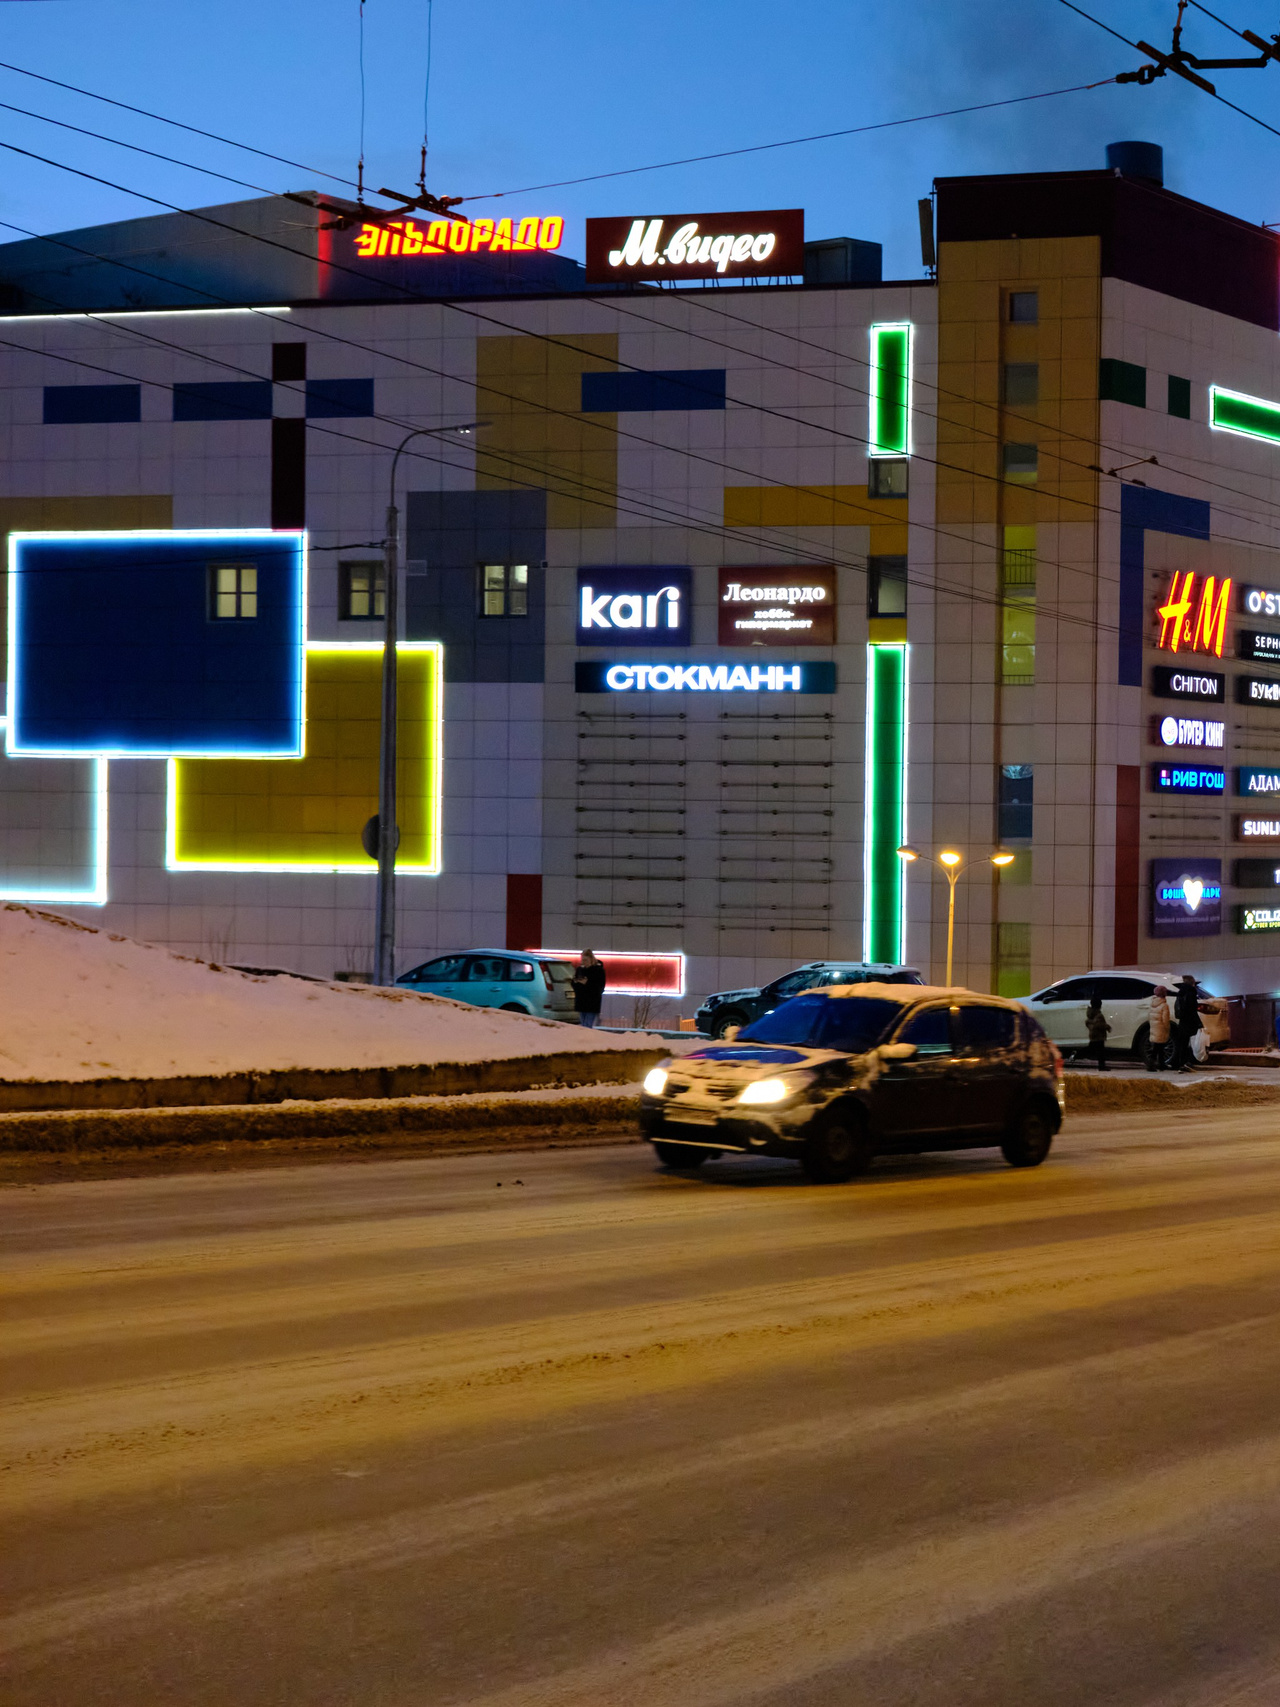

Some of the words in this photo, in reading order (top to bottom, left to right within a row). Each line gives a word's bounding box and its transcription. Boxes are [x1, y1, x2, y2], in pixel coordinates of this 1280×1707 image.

[354, 216, 564, 258] ЭЛЬДОРАДО
[581, 587, 680, 628] kari
[723, 584, 826, 605] Леонардо
[1158, 570, 1232, 659] H&M
[606, 665, 802, 691] СТОКМАНН
[1172, 674, 1218, 696] CHITON
[1178, 719, 1204, 746] БУРГЕР
[1205, 721, 1225, 748] КИНГ
[1172, 770, 1198, 788] РИВ
[1199, 772, 1225, 790] ГОШ
